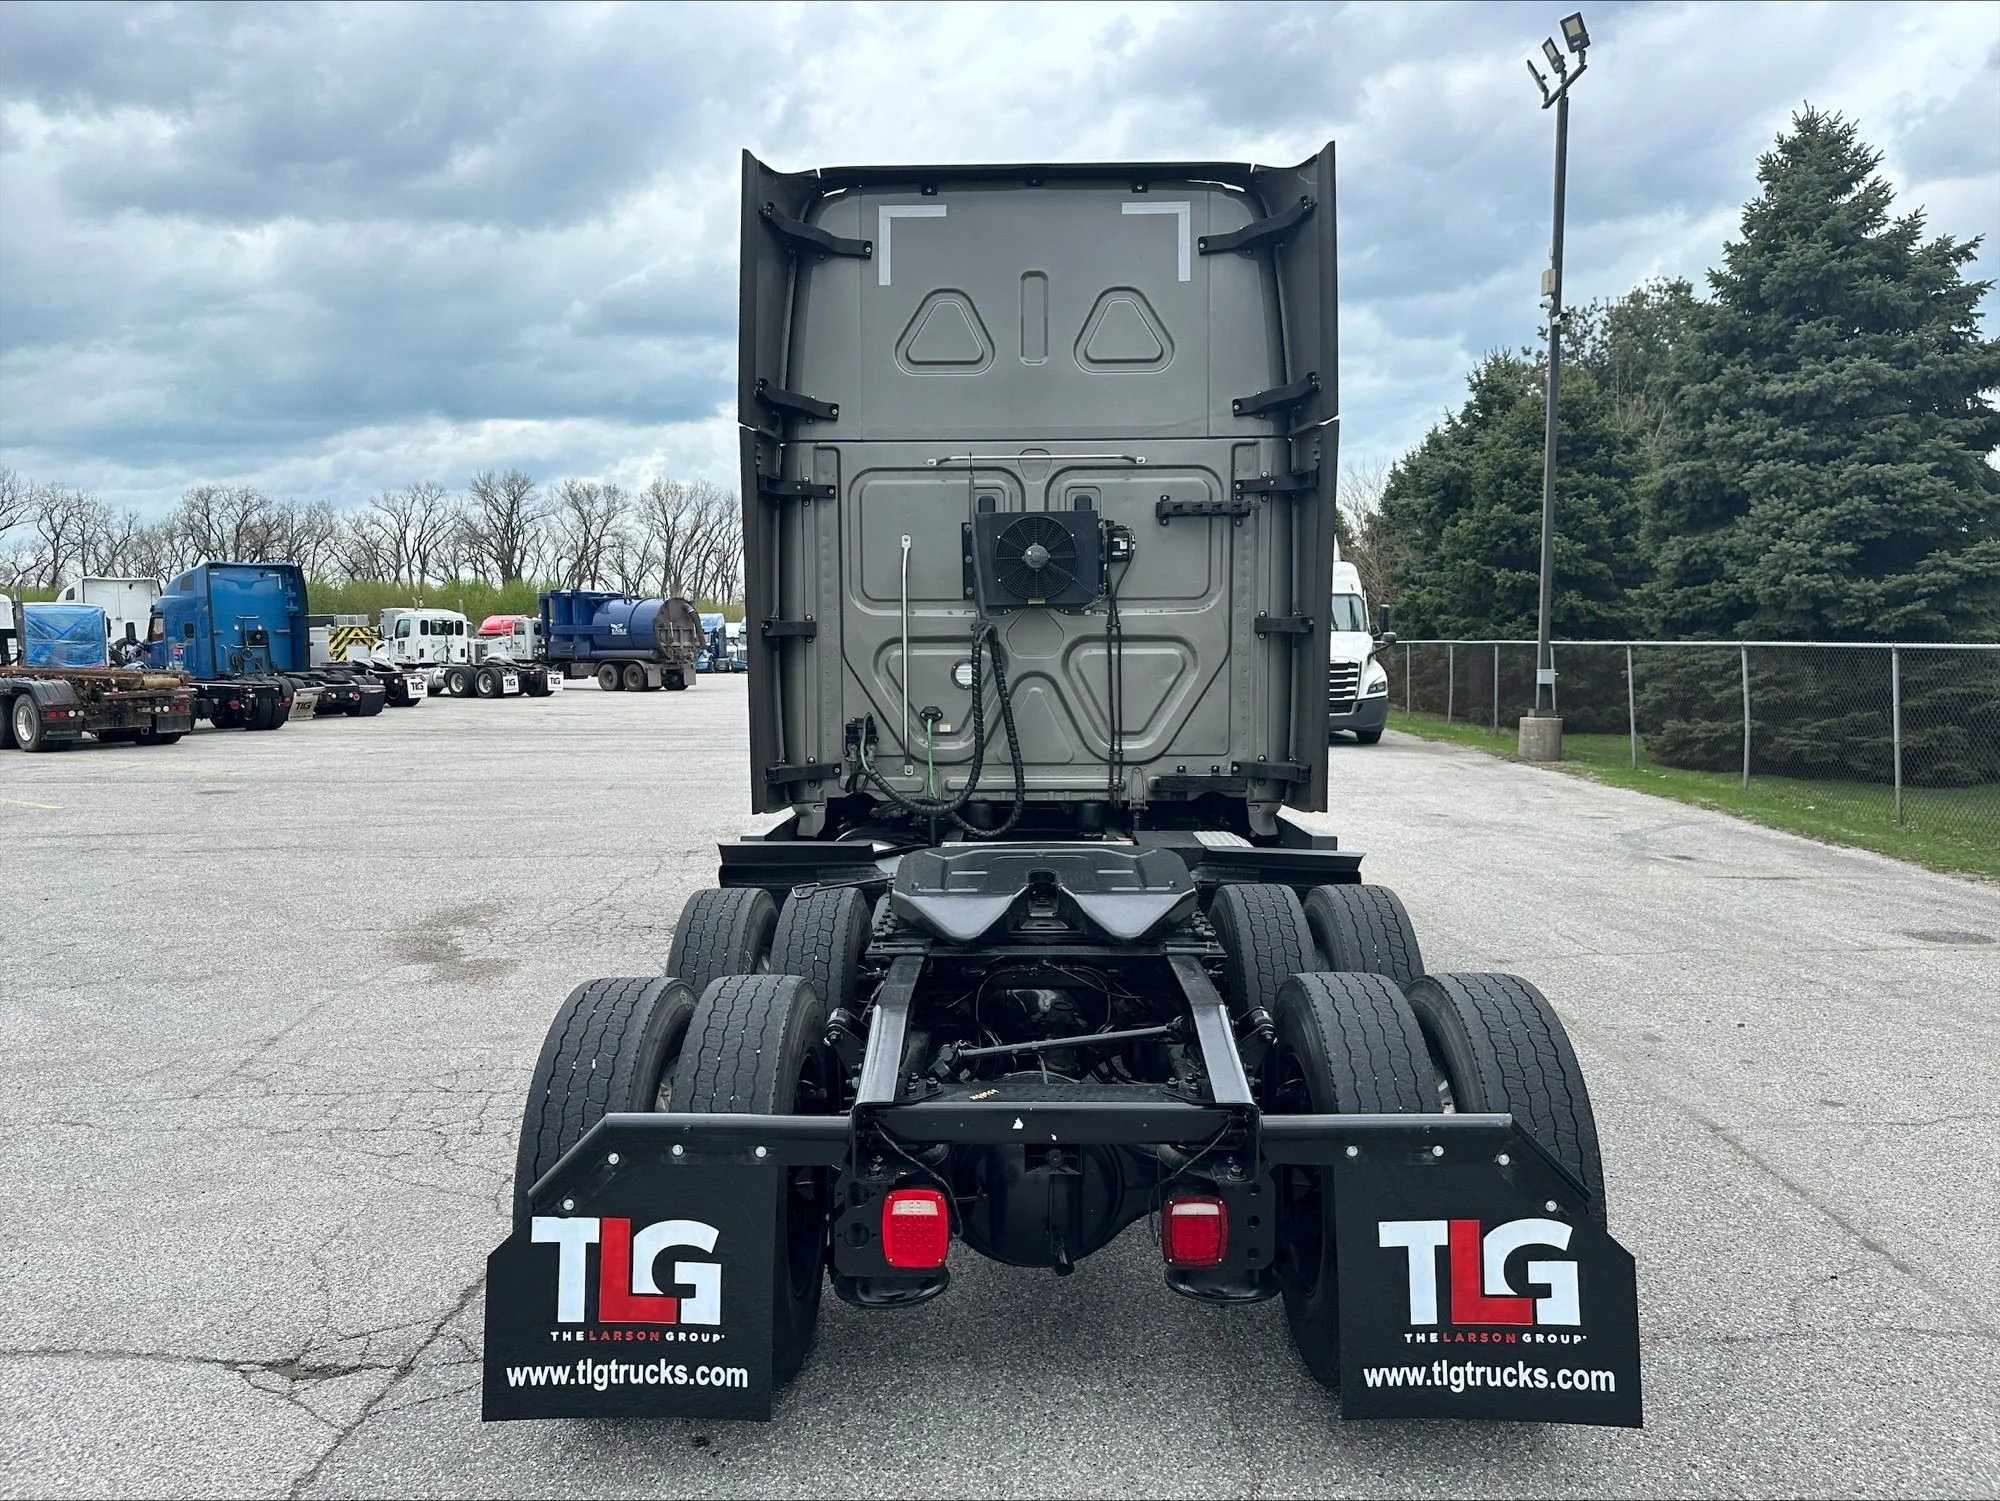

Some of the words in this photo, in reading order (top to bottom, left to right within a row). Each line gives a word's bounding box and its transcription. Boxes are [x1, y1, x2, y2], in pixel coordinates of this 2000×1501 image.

[531, 1216, 722, 1325] TLG
[1378, 1218, 1581, 1326] TLG
[550, 1331, 584, 1341] THE
[588, 1331, 660, 1342] LARSON
[665, 1332, 720, 1342] GROUP
[1404, 1333, 1438, 1343] THE
[1442, 1332, 1516, 1343] LARSON
[1522, 1333, 1582, 1344] GROUP
[506, 1359, 748, 1391] www.tlgtrucks.com
[1363, 1360, 1616, 1393] www.tlgtrucks.com
